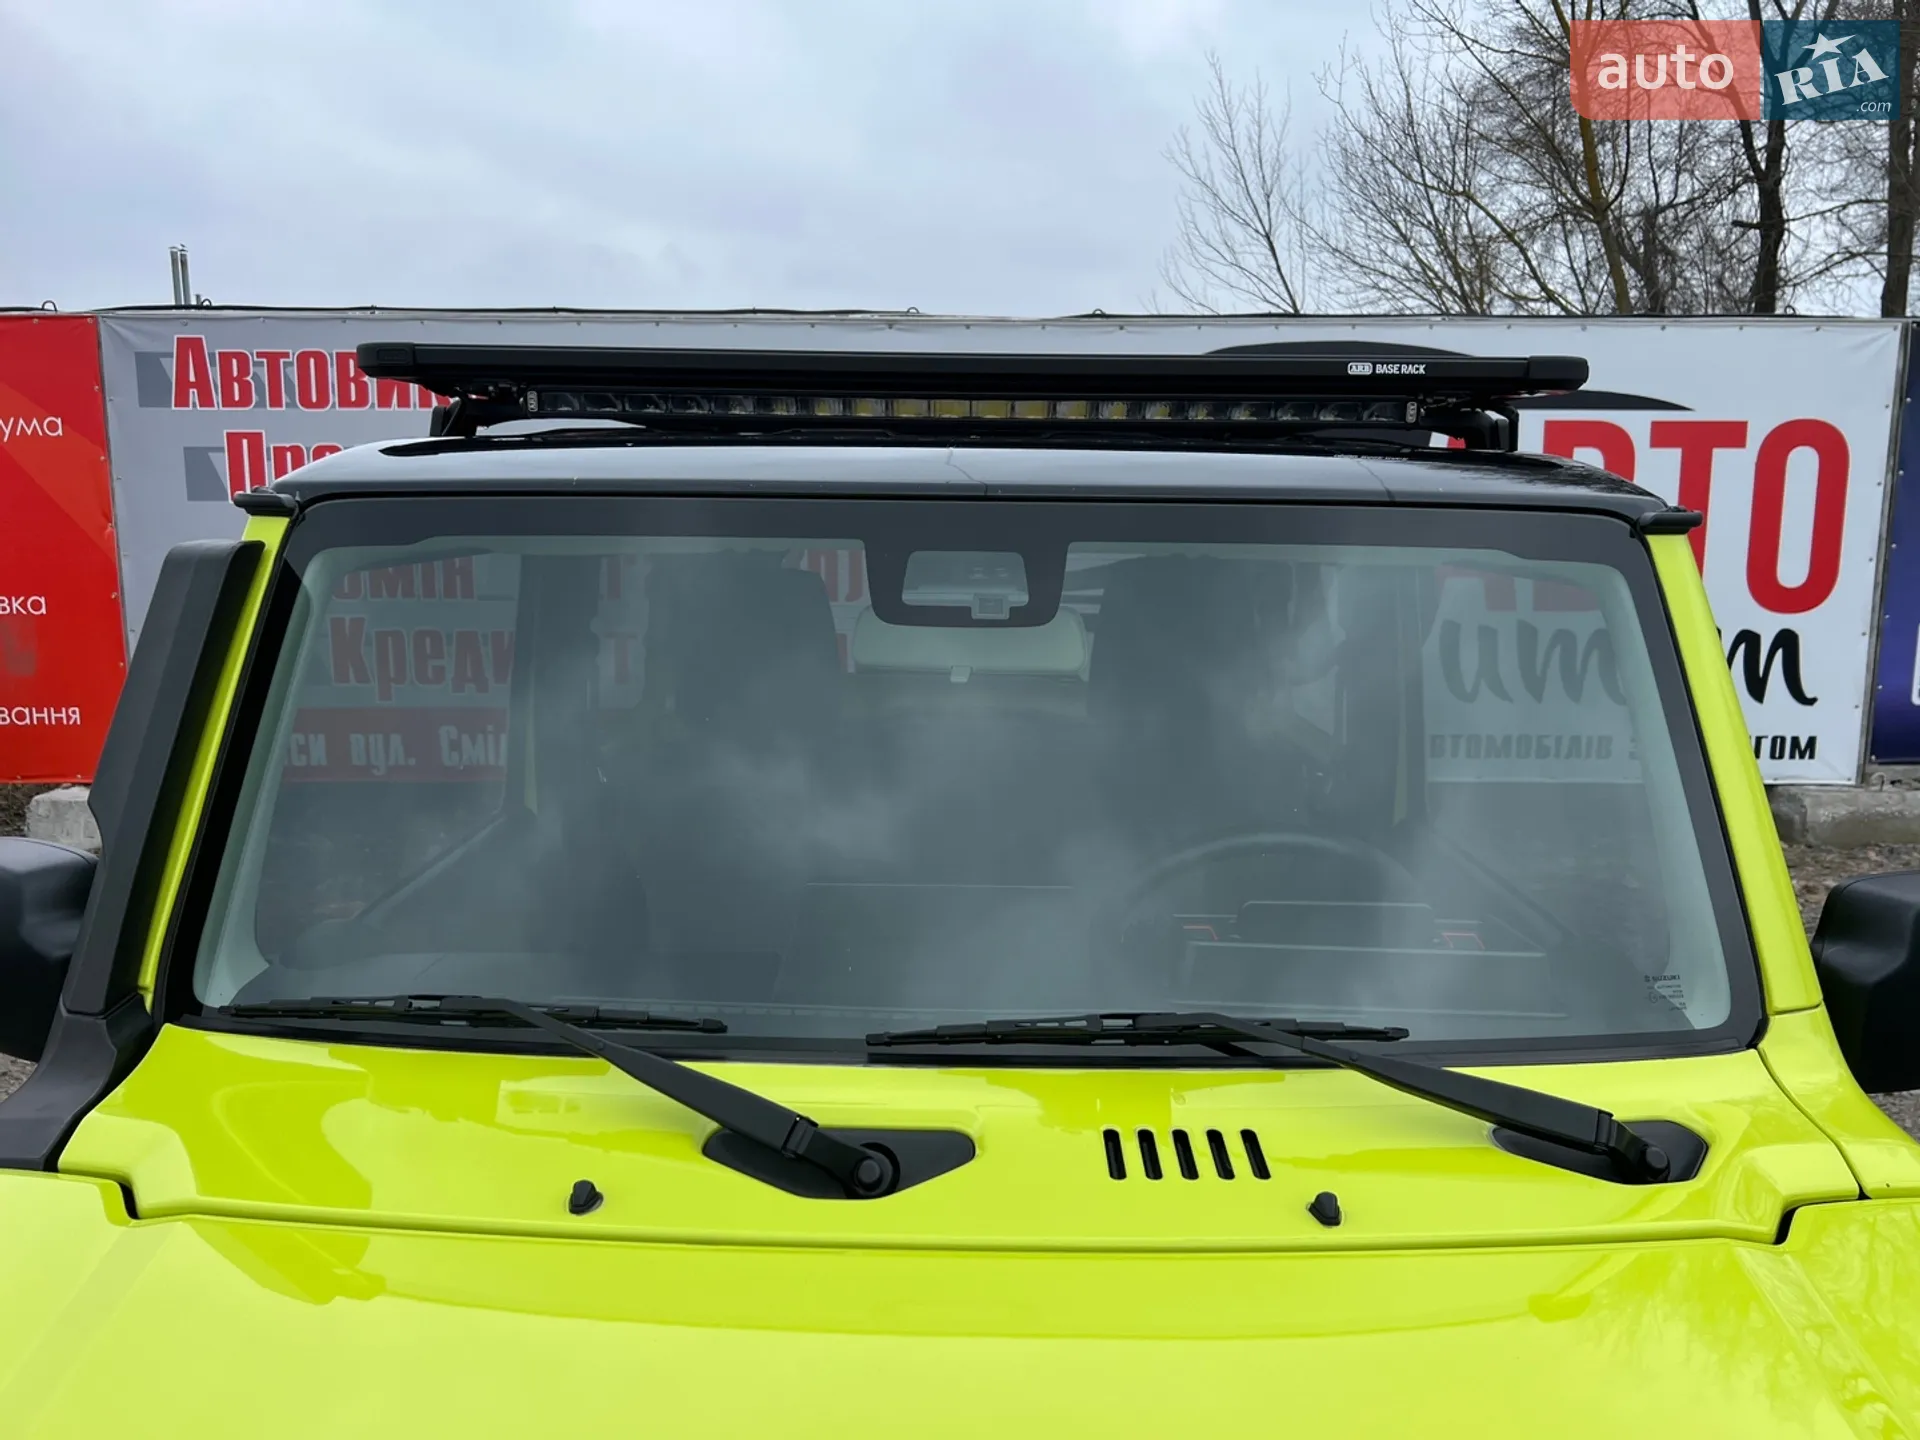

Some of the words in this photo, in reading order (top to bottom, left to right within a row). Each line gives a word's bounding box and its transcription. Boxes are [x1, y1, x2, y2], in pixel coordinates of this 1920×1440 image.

[1376, 364, 1400, 374] BASE
[1401, 364, 1426, 375] RACK
[328, 615, 515, 703] Креди
[286, 732, 328, 767] си
[350, 732, 416, 776] вул.
[1428, 734, 1614, 760] ВТОМОБІЛІВ
